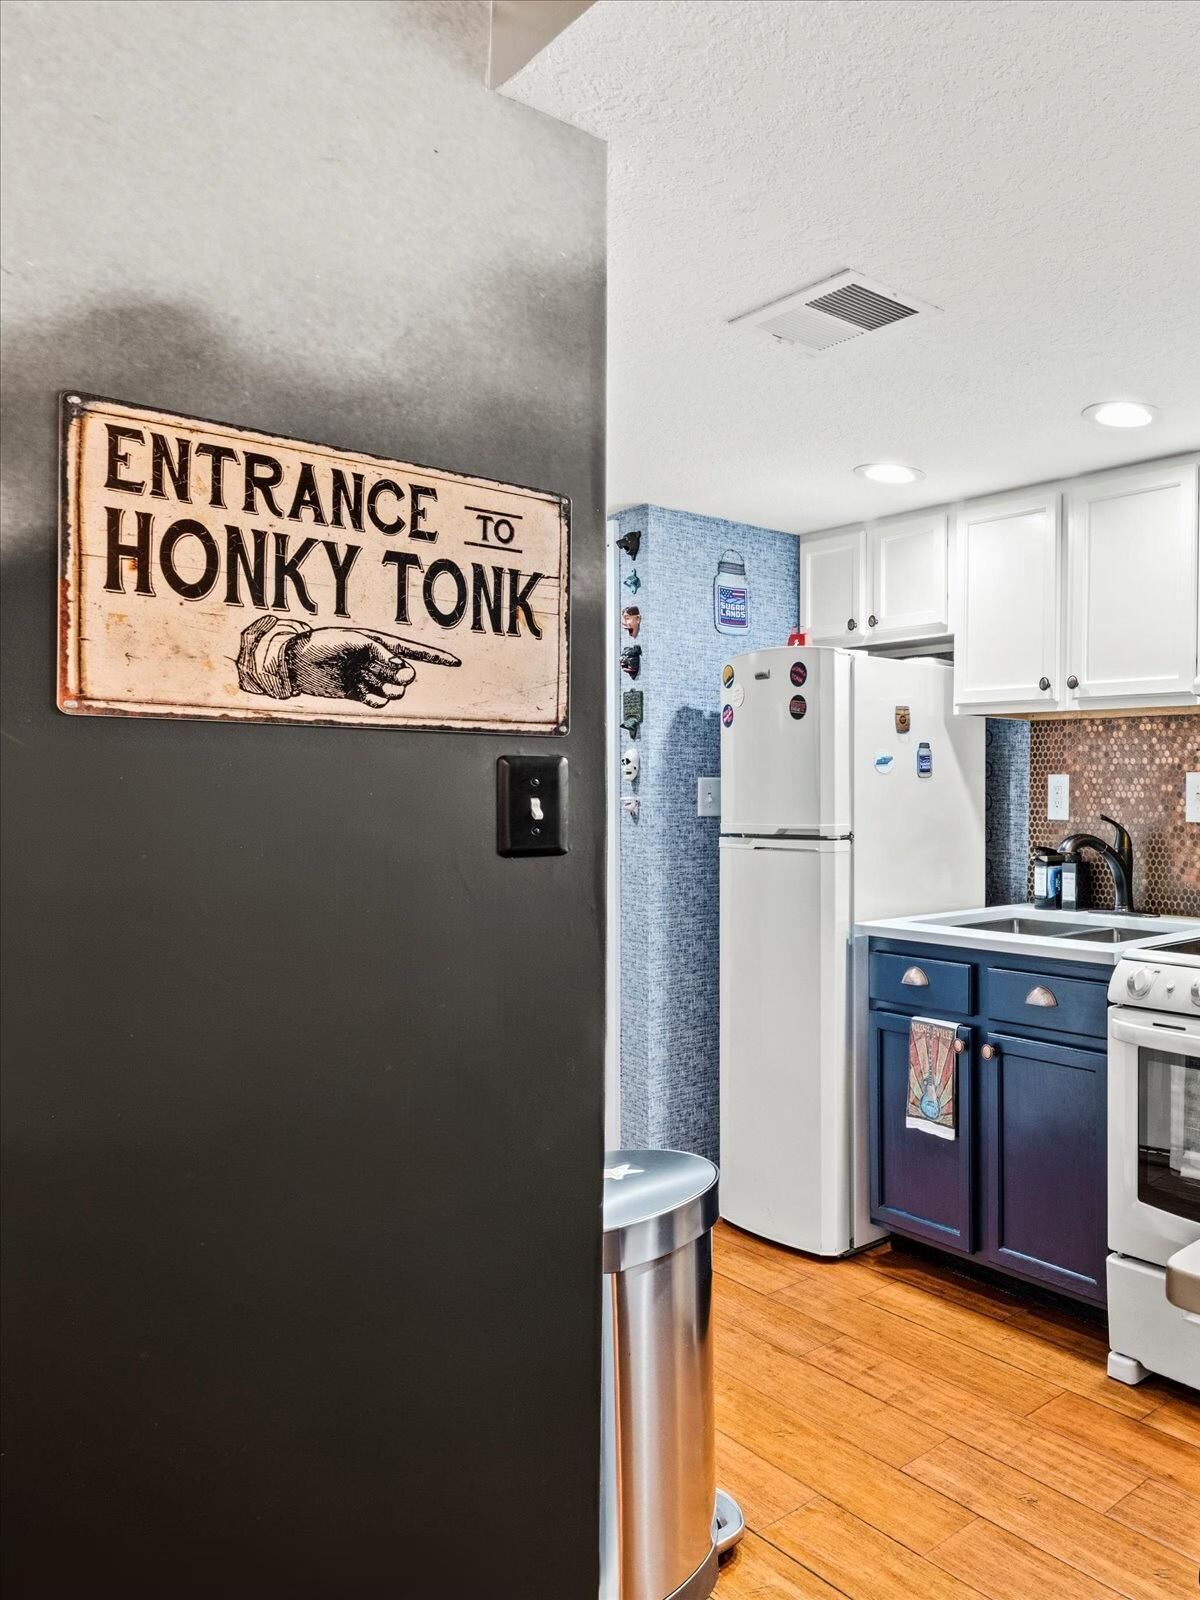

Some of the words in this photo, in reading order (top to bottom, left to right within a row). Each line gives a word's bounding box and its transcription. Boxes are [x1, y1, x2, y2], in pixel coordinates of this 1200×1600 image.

[103, 423, 439, 544] ENTRANCE
[476, 514, 515, 545] TO
[103, 506, 362, 619] HONKY
[382, 549, 546, 641] TONK
[720, 601, 745, 612] SUGAR
[720, 609, 746, 618] LANDS
